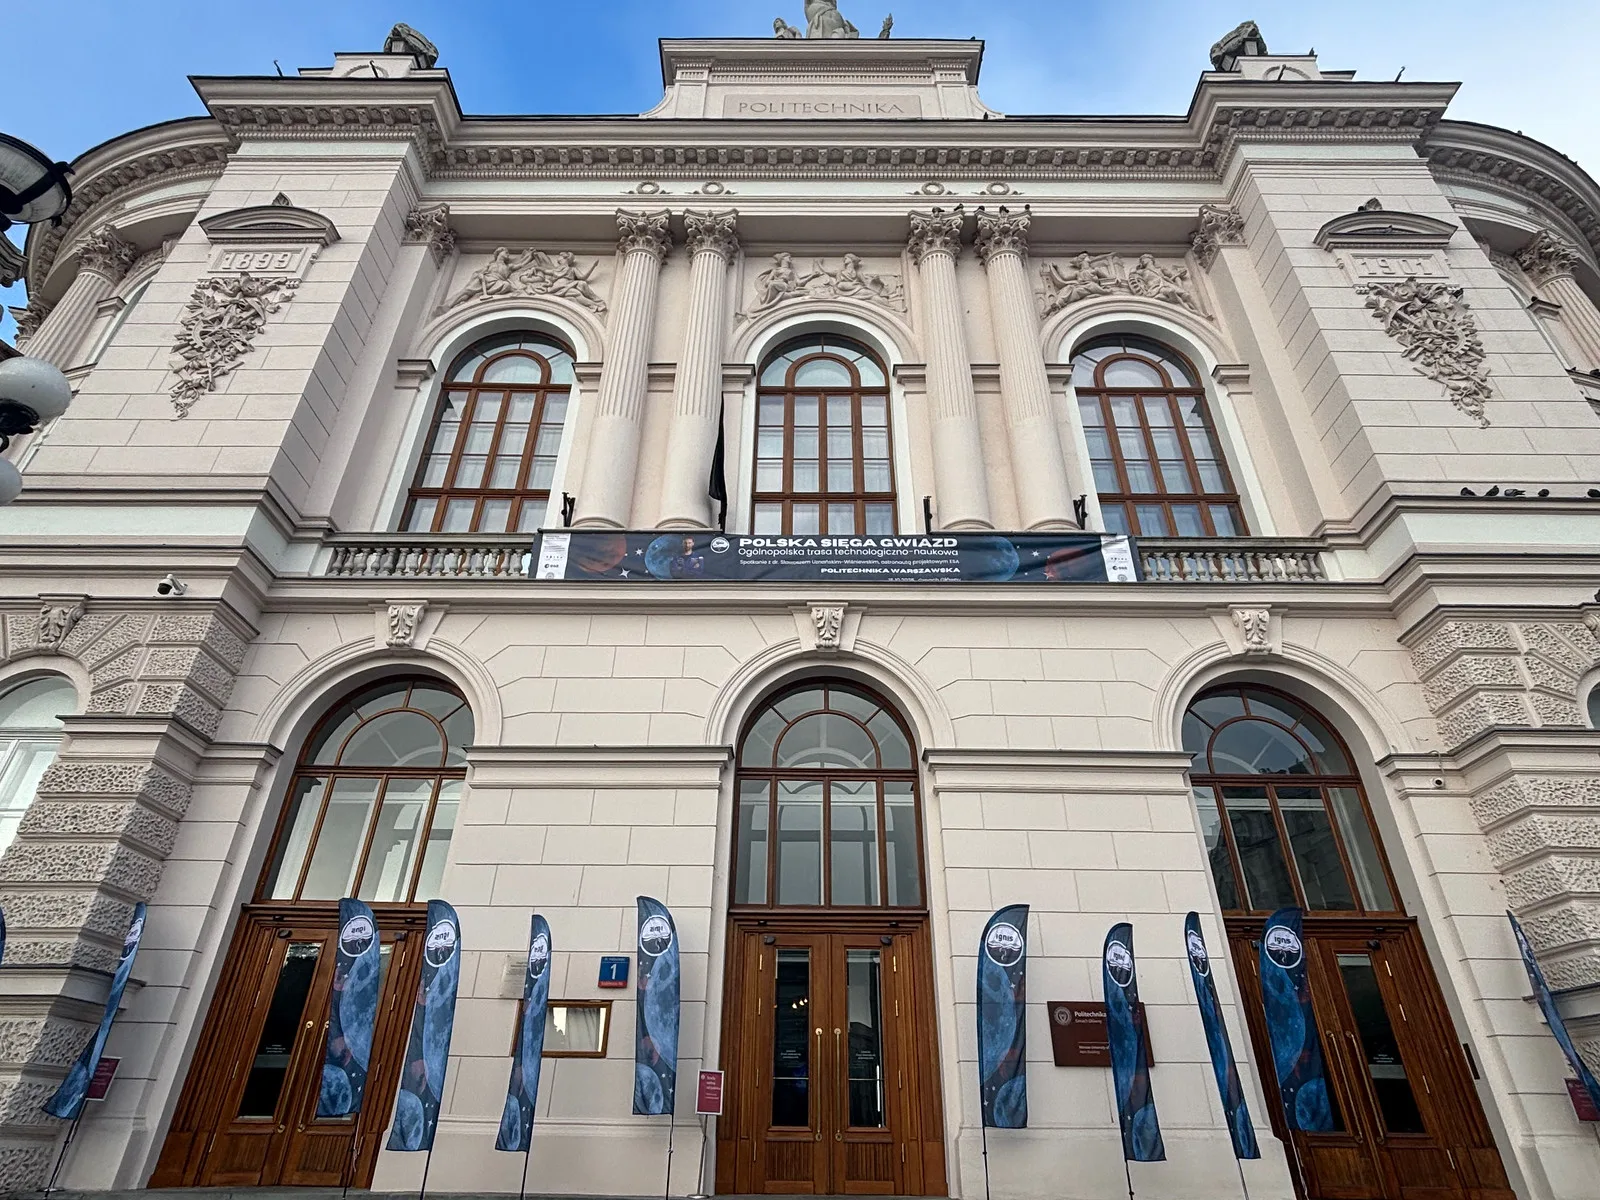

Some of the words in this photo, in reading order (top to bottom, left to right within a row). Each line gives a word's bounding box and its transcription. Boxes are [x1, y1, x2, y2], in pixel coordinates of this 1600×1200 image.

[738, 102, 904, 114] POLITECHNIKA
[221, 251, 293, 270] 1899
[1359, 257, 1433, 275] 1901
[739, 538, 818, 547] POLSKA
[820, 538, 878, 549] SIĘGA
[879, 538, 958, 548] GWIAZD
[738, 547, 805, 558] Ogólnopolska
[807, 548, 832, 556] trasa
[834, 547, 959, 558] technologiczno-naukowa
[610, 963, 617, 980] 1
